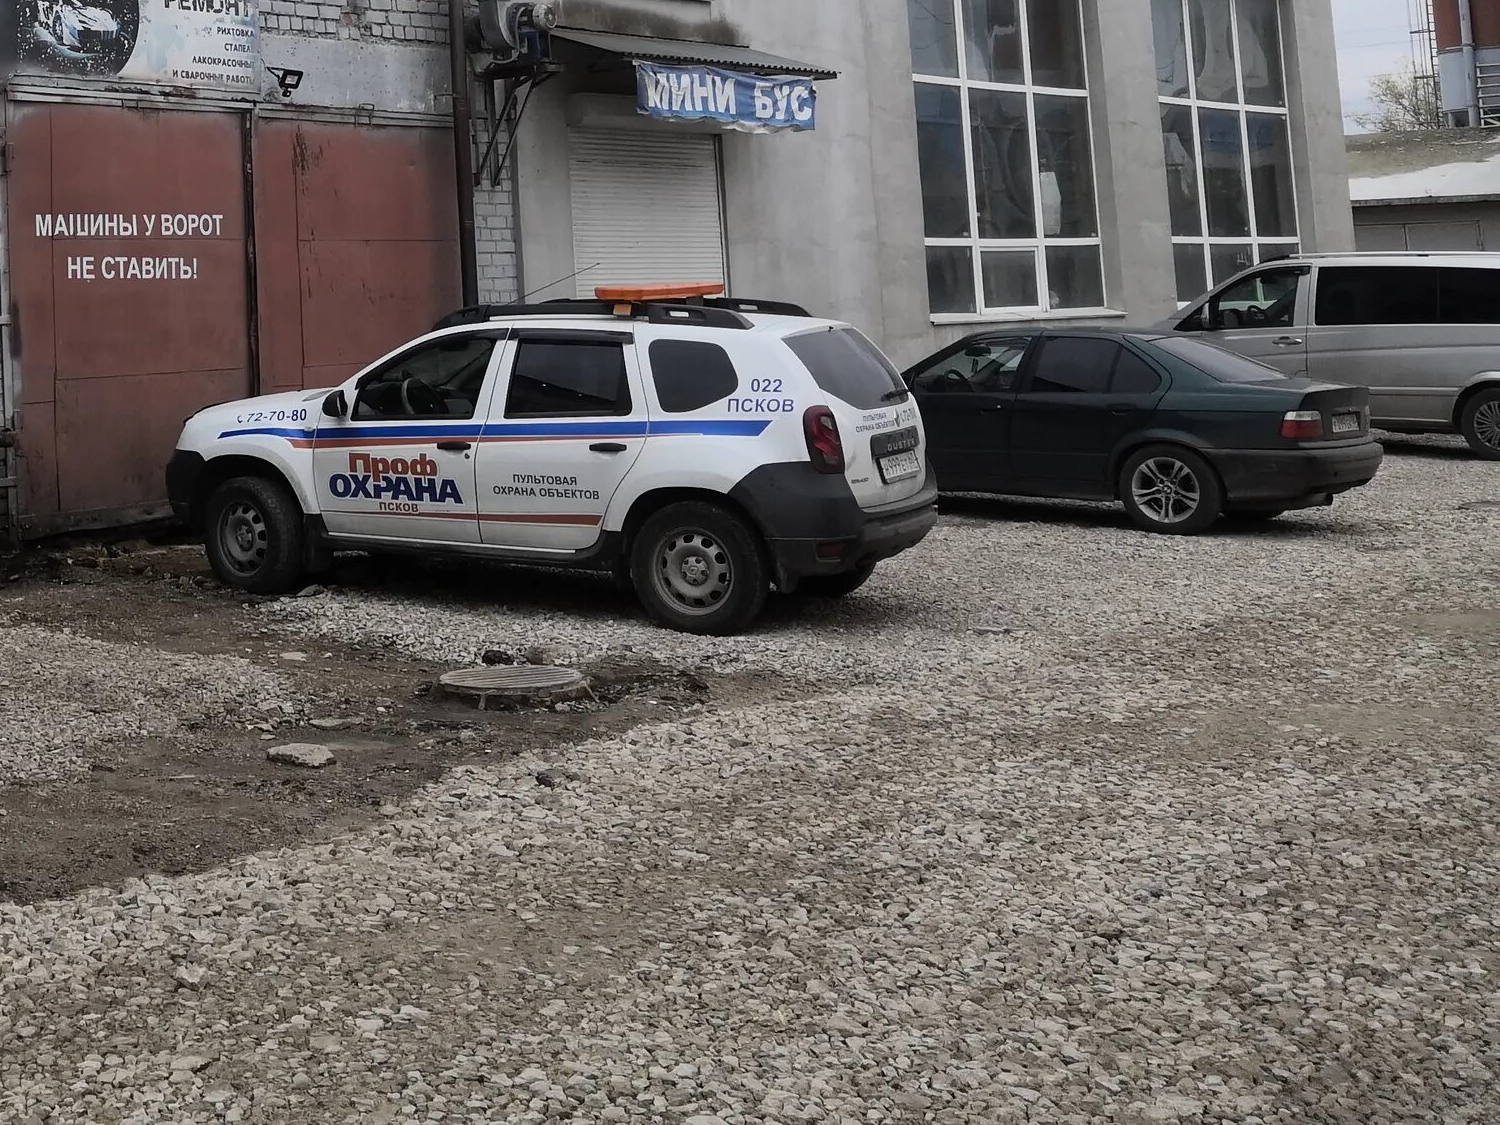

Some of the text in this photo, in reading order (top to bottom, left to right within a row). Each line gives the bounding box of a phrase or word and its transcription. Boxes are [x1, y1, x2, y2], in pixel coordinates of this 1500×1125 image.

[216, 26, 255, 37] РИХТОВКА
[172, 69, 178, 78] И
[755, 82, 812, 121] БУС
[35, 214, 223, 236] МАШИНЫ У ВОРОТ
[67, 256, 197, 279] НЕ СТАВИТЬ!
[751, 379, 782, 392] 022
[727, 398, 794, 412] ПСКОВ
[247, 408, 307, 423] 72-70-80
[349, 452, 438, 482] Проф
[513, 474, 577, 486] ПУЛЬТОВАЯ
[329, 473, 463, 504] ОХРАНА
[493, 486, 600, 500] ОХРАНА ОБЪЕКТОВ
[379, 501, 418, 513] ПСКОВ
